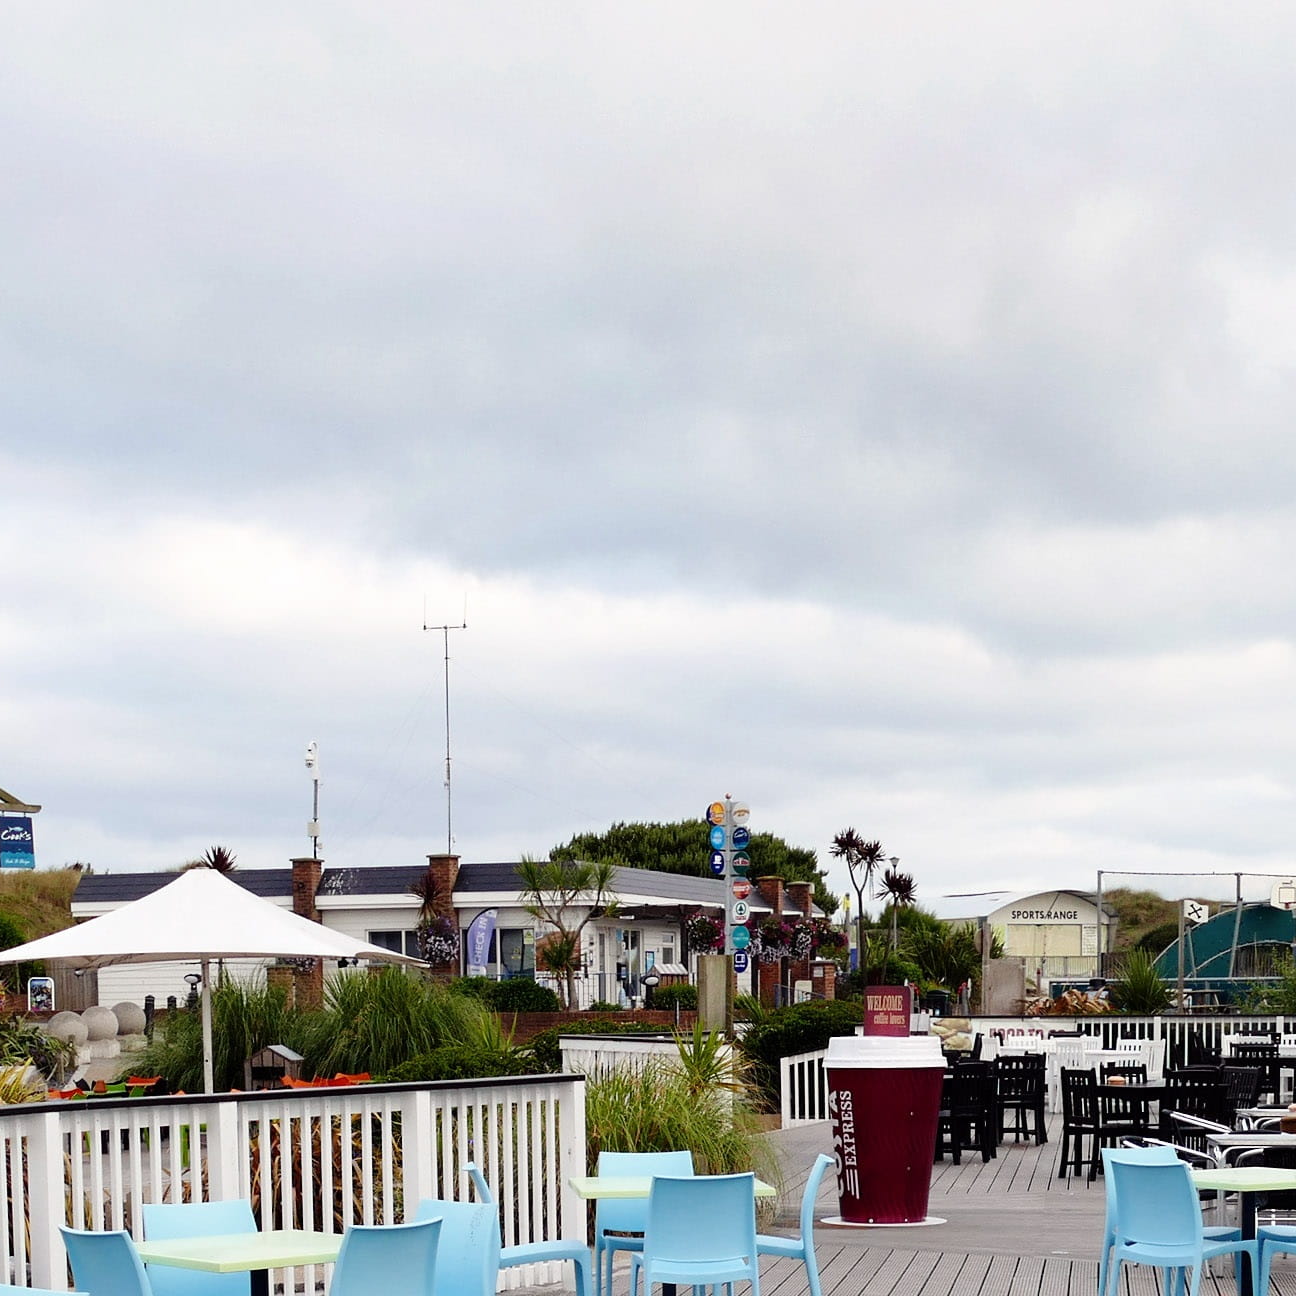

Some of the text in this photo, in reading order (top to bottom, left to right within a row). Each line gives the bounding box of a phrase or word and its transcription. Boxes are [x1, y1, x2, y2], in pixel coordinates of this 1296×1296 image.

[1, 830, 31, 841] Cook's
[1012, 911, 1078, 919] SPORTS RANGE
[473, 932, 485, 965] CHECK
[479, 917, 488, 929] IN
[867, 995, 903, 1011] WELCOME
[839, 1090, 857, 1166] EXPRESS
